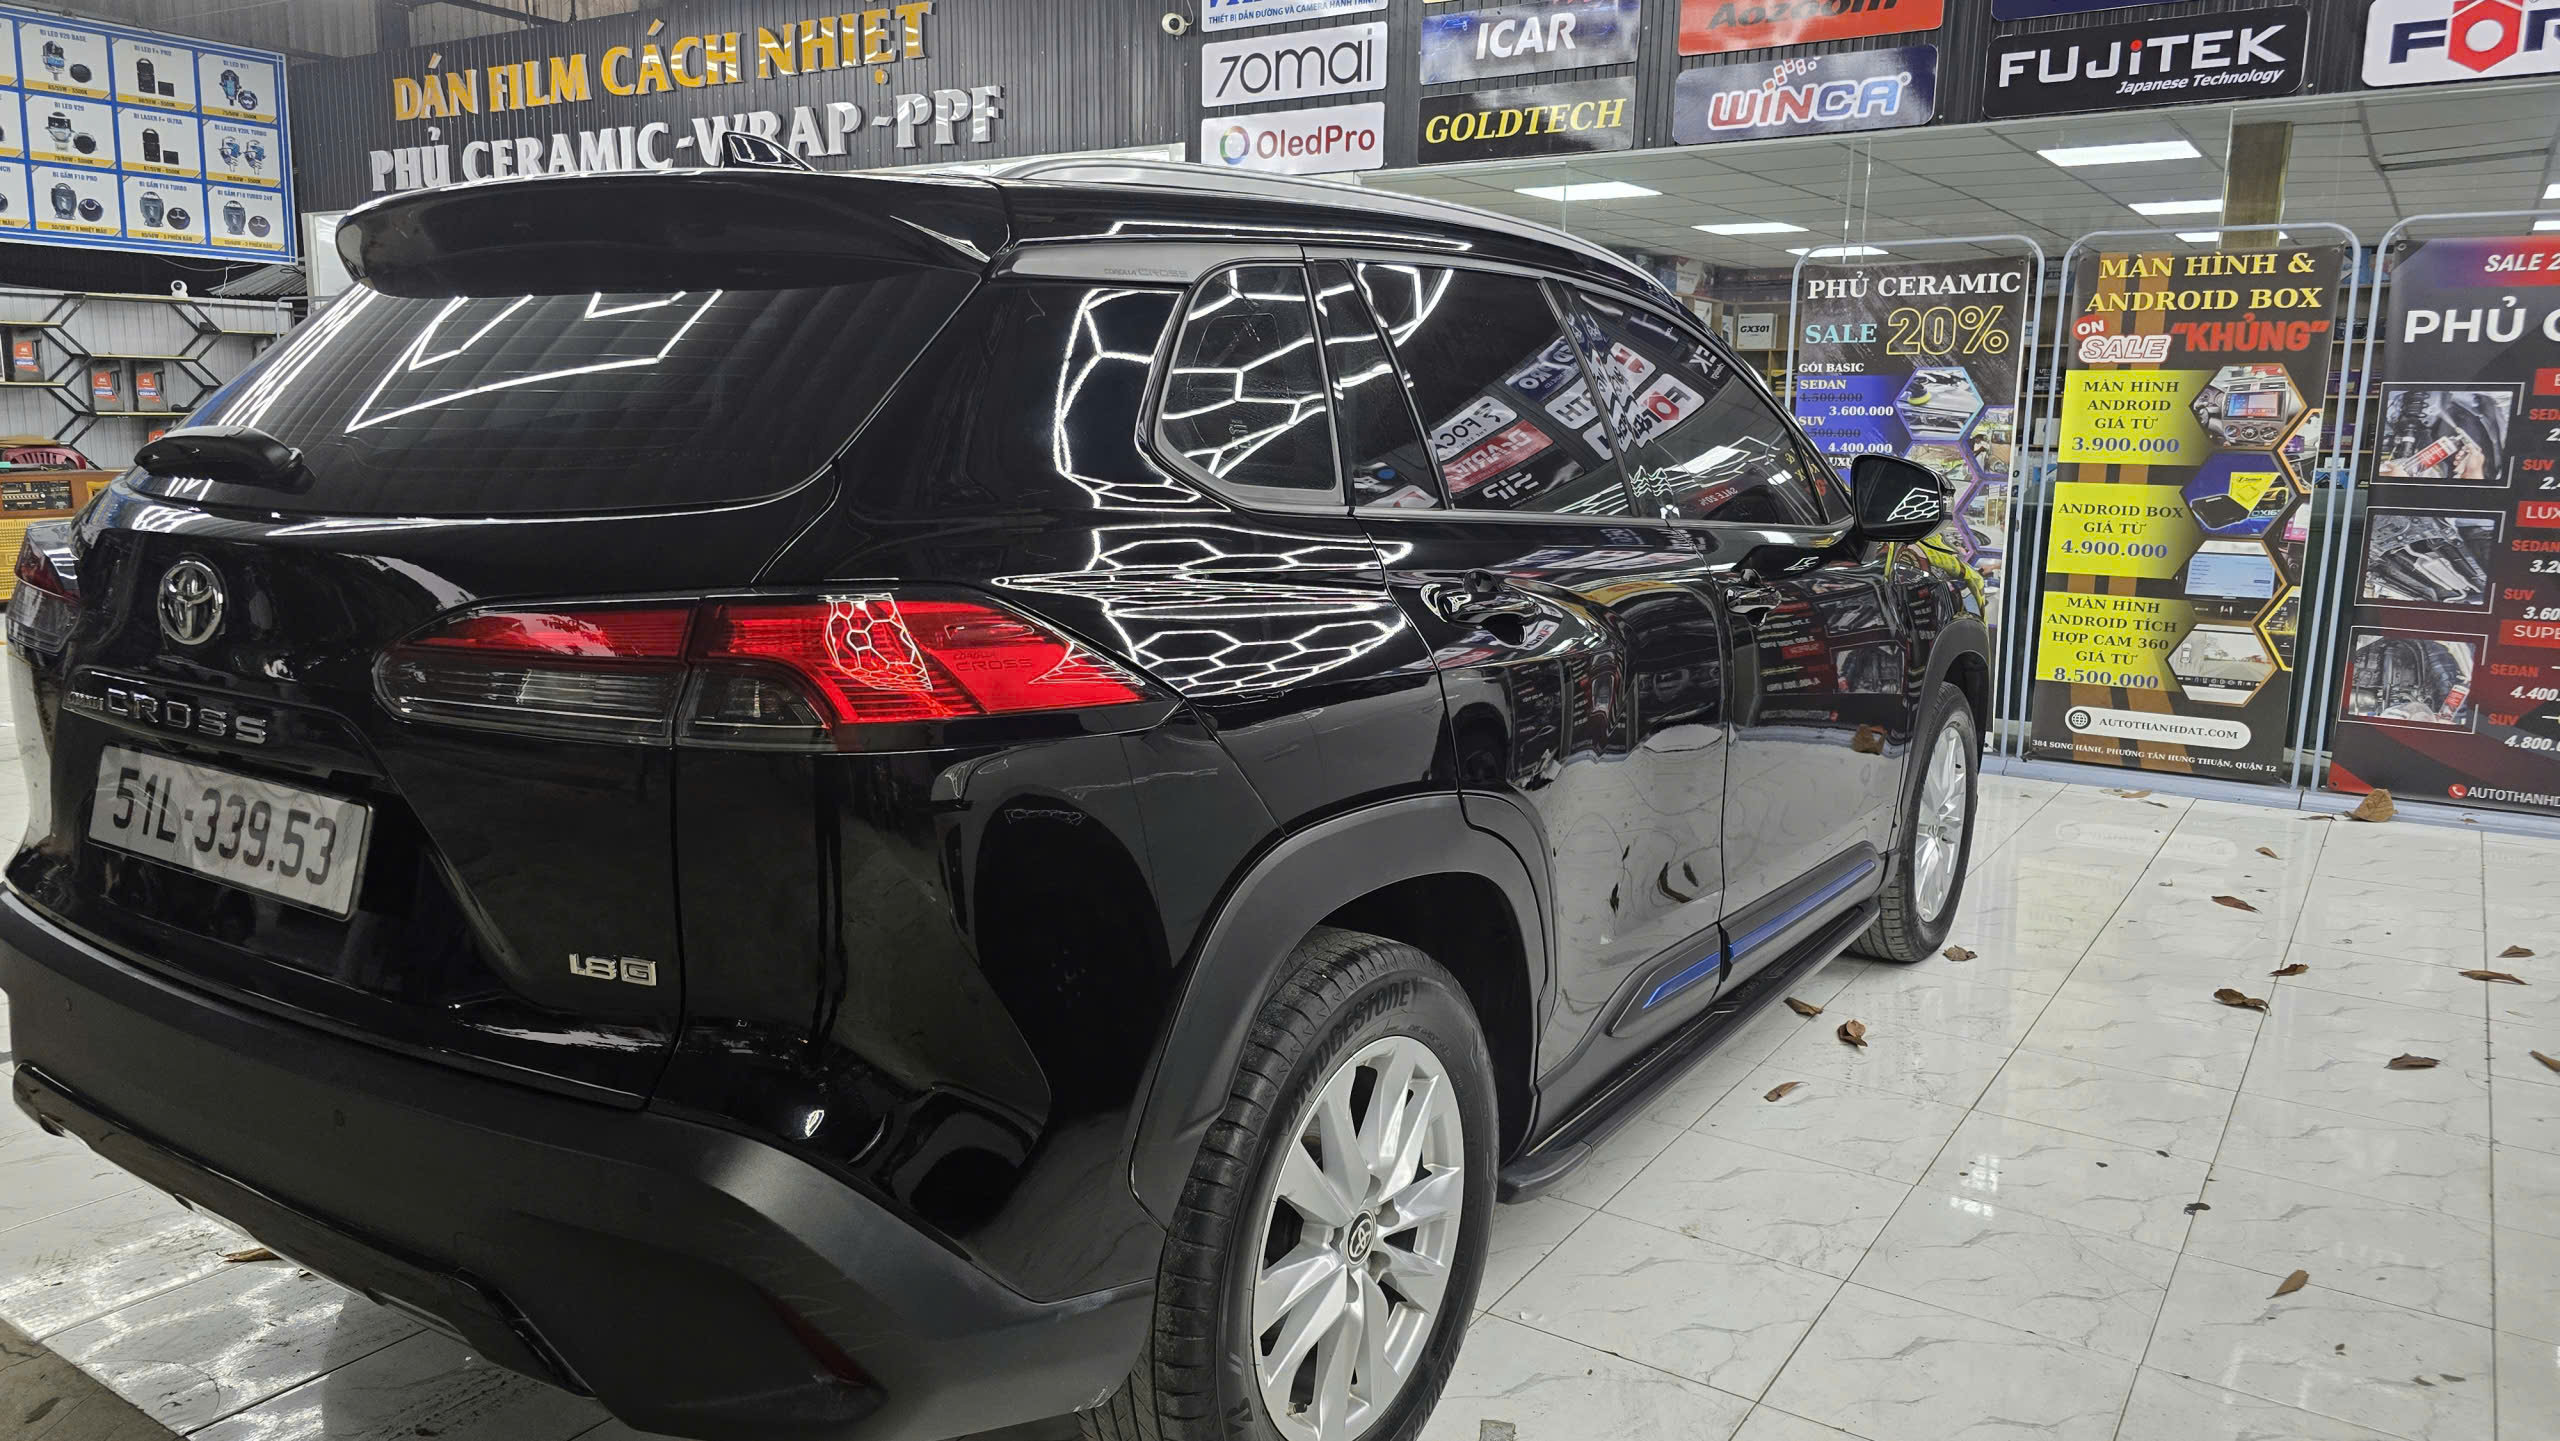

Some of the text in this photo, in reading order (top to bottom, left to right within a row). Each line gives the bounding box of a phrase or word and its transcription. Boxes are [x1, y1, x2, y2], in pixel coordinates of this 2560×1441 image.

[1208, 14, 1229, 24] THIẾT
[1230, 14, 1237, 23] BỊ
[1238, 10, 1254, 21] DẪN
[1256, 7, 1284, 19] ĐƯỜNG
[1285, 4, 1295, 14] VÀ
[1296, 3, 1327, 13] CAMERA
[1475, 13, 1577, 60] ICAR
[393, 2, 936, 120] DÁN FILM CÁCH NHIỆT
[1216, 28, 1372, 97] 70mai
[2115, 68, 2285, 95] Japanese Technology
[1425, 99, 1627, 144] GOLDTECH
[1256, 123, 1375, 158] OledPro
[370, 126, 451, 191] PHỦ
[2100, 250, 2315, 279] MÀN HÌNH &
[2484, 253, 2545, 272] SALE
[1807, 271, 2021, 299] PHỦ CERAMIC
[2085, 287, 2323, 313] ANDROID BOX
[2076, 319, 2105, 335] ON
[2404, 296, 2527, 343] PHỦ
[1805, 305, 2010, 355] SALE 20%
[2081, 336, 2169, 361] SALE
[1799, 362, 1864, 373] GÓI BASIC
[1800, 379, 1847, 390] SEDAN
[2084, 379, 2179, 392] MÀN HÌNH
[1829, 406, 1894, 416] 3.600.000
[2088, 400, 2171, 411] ANDROID
[1799, 416, 1826, 426] SUV
[2095, 416, 2158, 429] GIÁ TỪ
[1828, 443, 1893, 453] 4.400.000
[2072, 437, 2180, 453] 3.900.000
[2522, 458, 2554, 471] SUV
[2058, 503, 2184, 519] ANDROID BOX
[2083, 520, 2147, 534] GIÁ TỪ
[2061, 540, 2168, 558] 4.900.000
[2503, 587, 2536, 601] SUV
[2067, 596, 2160, 614] MÀN HÌNH
[2047, 613, 2177, 632] ANDROID TÍCH
[2052, 631, 2169, 650] HỢP CAM 360
[956, 657, 1033, 672] CROSS
[2076, 650, 2138, 665] GIÁ TỪ
[2054, 667, 2159, 689] 8.500.000
[2490, 662, 2540, 678] SEDAN
[107, 687, 268, 745] CROSS
[2488, 712, 2520, 726] SUV
[2099, 717, 2239, 740] AUTOTHANHDAT.COM
[2032, 739, 2047, 747] 384
[2049, 741, 2073, 750] SONG
[2235, 761, 2264, 772] QUẬN
[2266, 765, 2277, 773] 12
[112, 767, 337, 886] 51L-339.53
